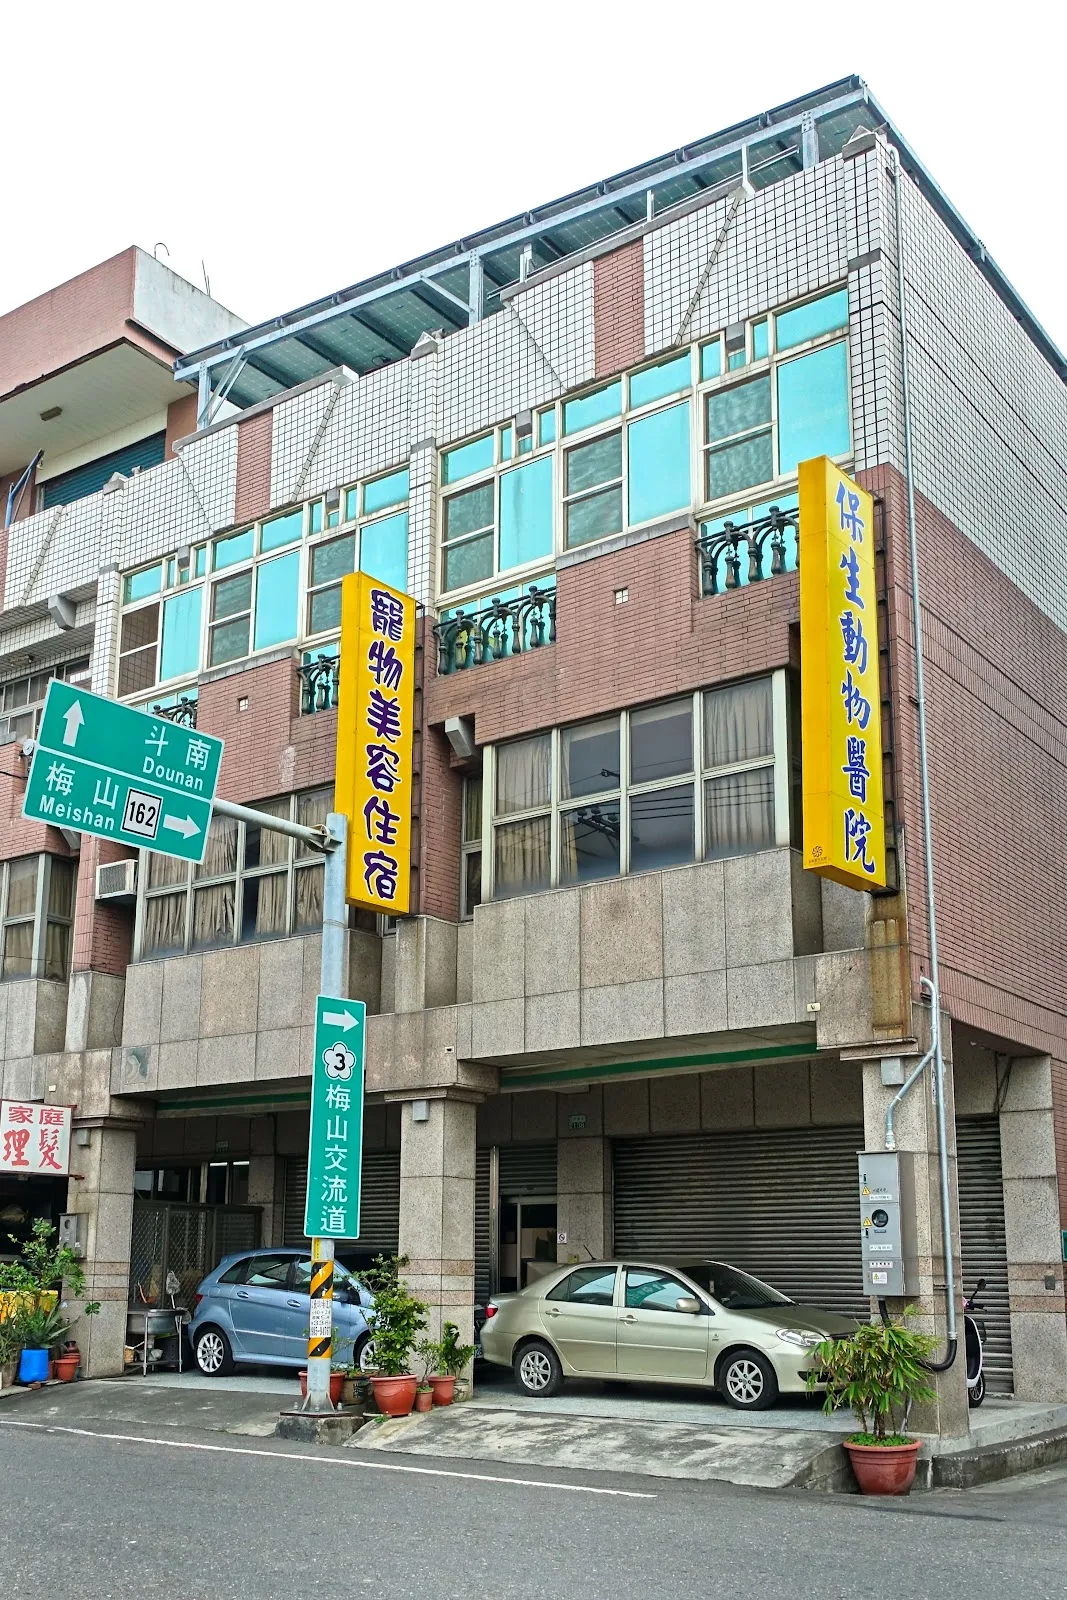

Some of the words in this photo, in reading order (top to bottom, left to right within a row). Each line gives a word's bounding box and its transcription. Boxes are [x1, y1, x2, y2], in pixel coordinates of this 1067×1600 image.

[835, 480, 876, 874] 保生動物醫院
[145, 725, 212, 772] 斗南
[363, 588, 405, 900] 寵物美容住宿
[45, 760, 119, 810] 梅山
[142, 756, 204, 791] Dounan
[39, 794, 115, 831] Meishan
[128, 801, 156, 828] 162
[333, 1052, 346, 1071] 3
[8, 1106, 65, 1126] 家庭
[3, 1128, 62, 1170] 理髮
[320, 1083, 351, 1233] 梅山交流道
